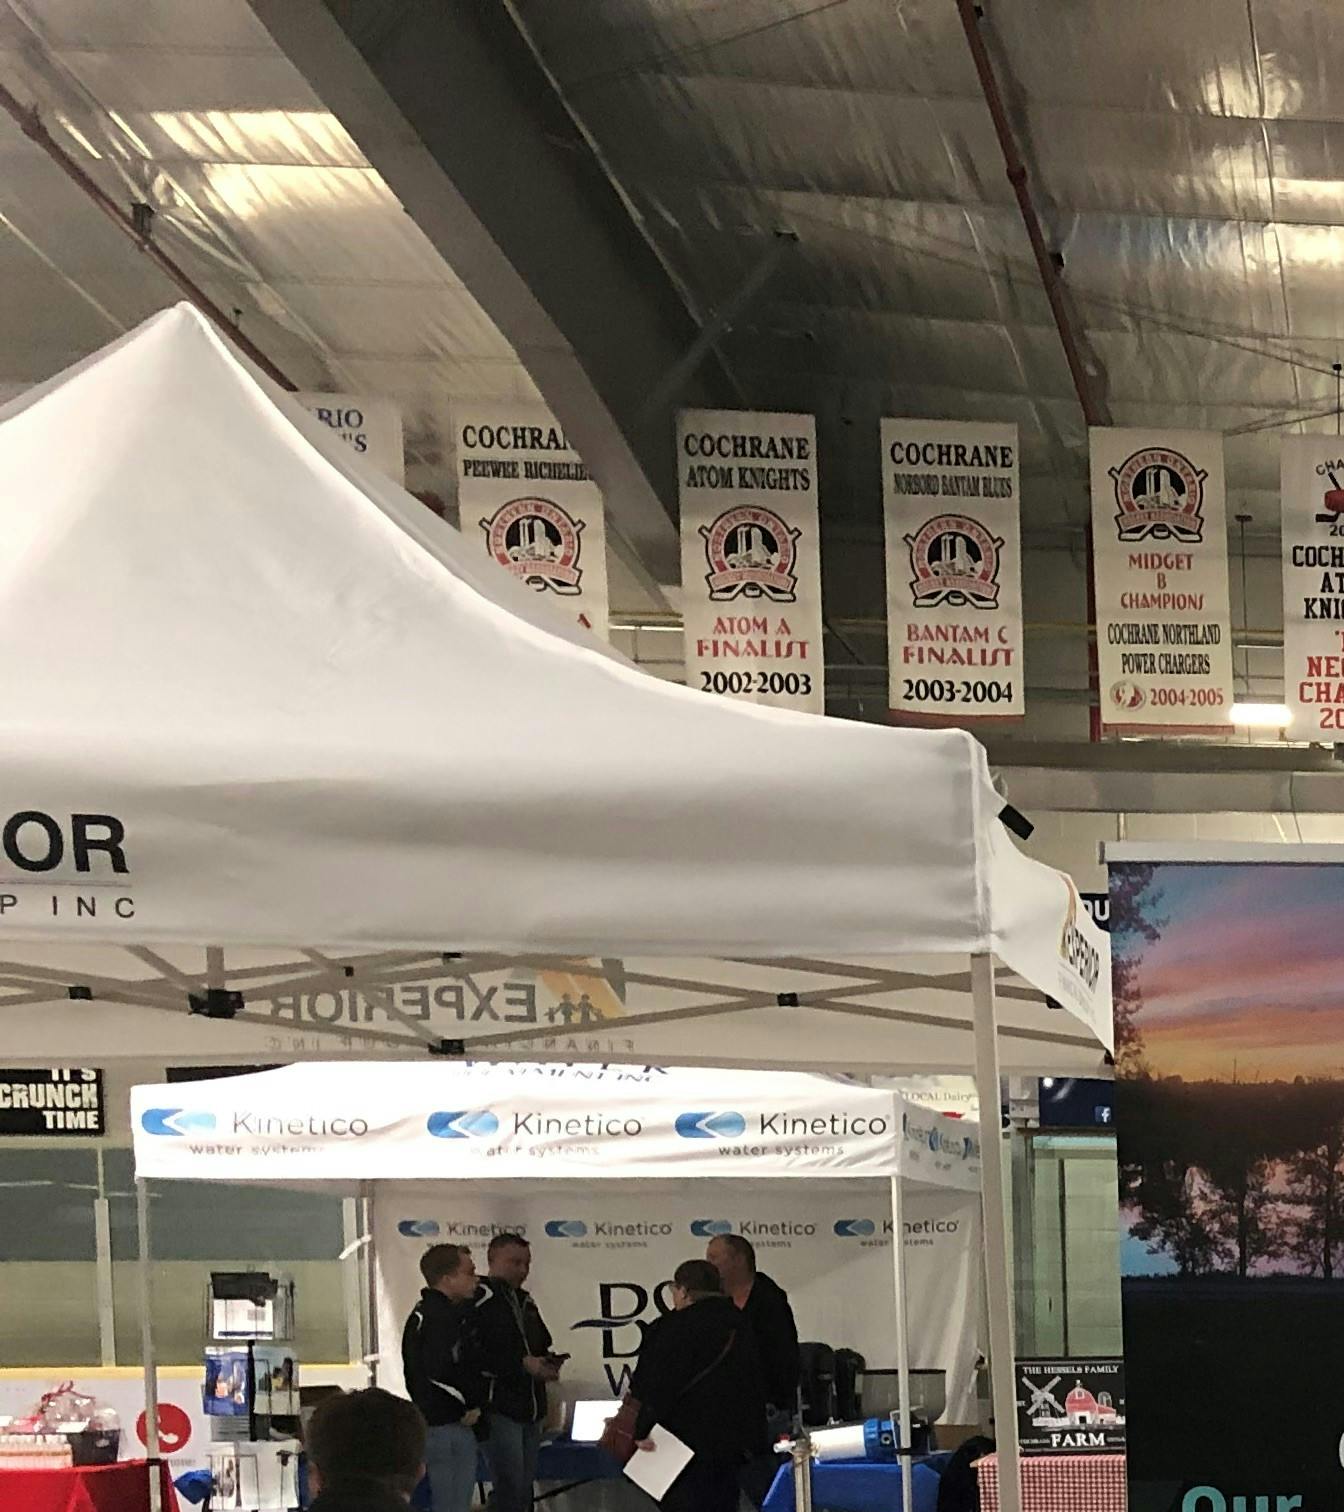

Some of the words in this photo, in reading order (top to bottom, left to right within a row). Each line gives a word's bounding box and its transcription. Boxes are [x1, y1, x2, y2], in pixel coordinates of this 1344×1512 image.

[684, 434, 809, 460] COCHRANE
[891, 442, 1013, 468] COCHRANE
[463, 459, 520, 479] PEEWEE
[687, 465, 732, 488] ATOM
[738, 467, 810, 491] KNIGHTS
[1128, 553, 1193, 570] MIDGET
[1108, 624, 1160, 644] COCHRANE
[1162, 624, 1221, 645] NORTHLAND
[697, 639, 809, 660] FINALIST
[902, 646, 1014, 667] FINALIST
[1121, 654, 1155, 674] POWER
[1159, 654, 1210, 674] CHARGERS
[700, 671, 812, 695] 2002-2003
[903, 679, 1013, 702] 2003-2004
[52, 895, 136, 918] INC
[0, 1084, 98, 1109] CRUNCH
[43, 1110, 100, 1130] TIME
[233, 1111, 368, 1136] Kinetico
[513, 1112, 642, 1137] Kinetico
[760, 1112, 887, 1137] Kinetico
[718, 1145, 768, 1156] water
[775, 1145, 845, 1158] systems
[594, 1219, 674, 1237] Kinetico
[740, 1219, 817, 1237] Kinetico
[1051, 1433, 1105, 1447] FARM
